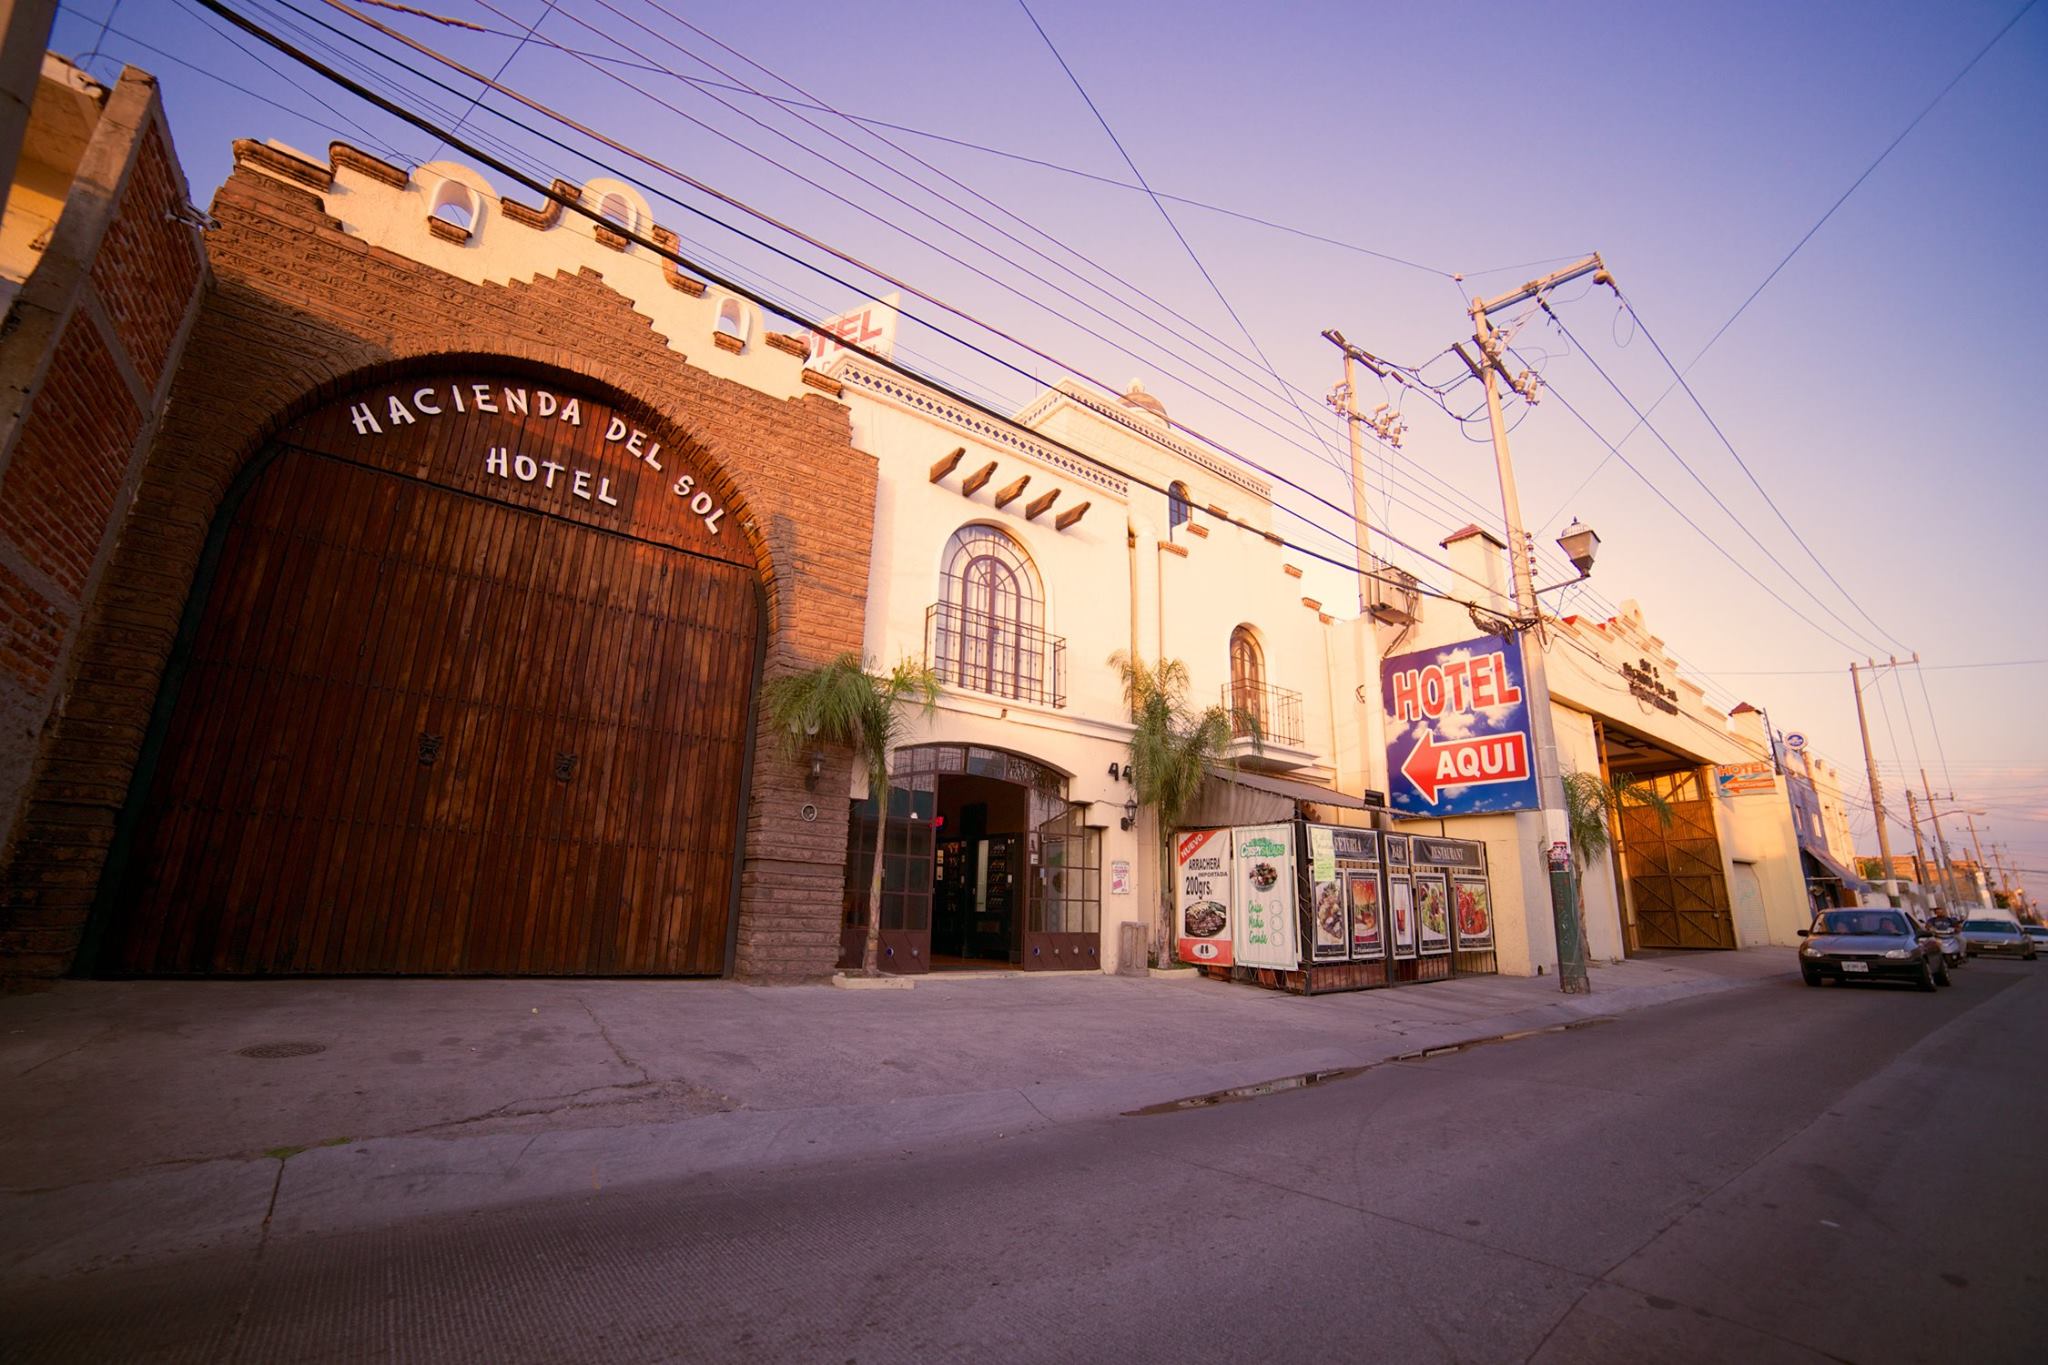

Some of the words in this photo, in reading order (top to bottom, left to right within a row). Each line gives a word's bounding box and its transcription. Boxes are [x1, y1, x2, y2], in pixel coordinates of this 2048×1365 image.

[796, 309, 883, 359] TEL
[350, 384, 581, 435] HACIENDA
[604, 416, 664, 471] DEL
[673, 474, 727, 535] SOL
[485, 446, 618, 507] HOTEL
[1392, 651, 1522, 722] HOTEL
[1436, 741, 1516, 780] AQUI
[1717, 763, 1771, 775] HOTEL
[1181, 833, 1204, 858] NUEVO
[1333, 837, 1362, 852] FETERIA
[1391, 844, 1404, 859] BAR
[1189, 857, 1221, 870] ARRACHERA
